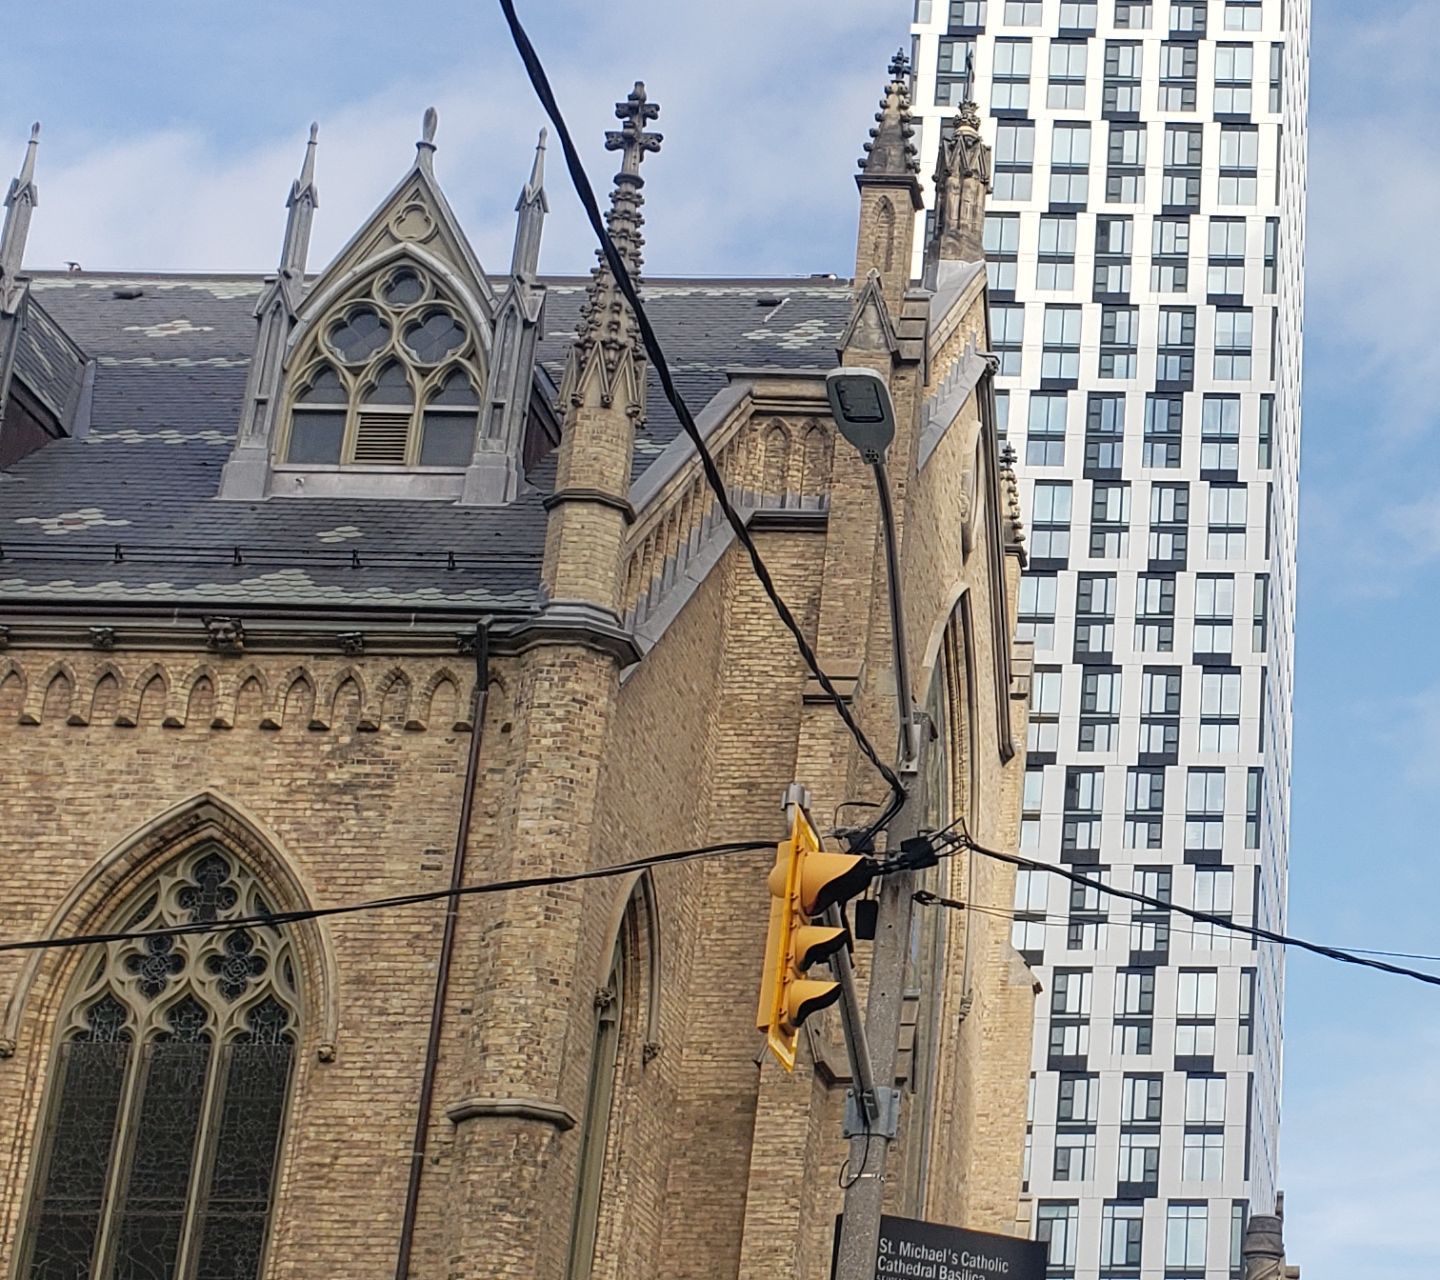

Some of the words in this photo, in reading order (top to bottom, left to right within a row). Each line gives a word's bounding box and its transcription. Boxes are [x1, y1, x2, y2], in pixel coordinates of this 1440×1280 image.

[877, 1255, 936, 1278] Cathedral
[879, 1237, 896, 1255] St.
[899, 1240, 959, 1265] Michael's
[961, 1251, 1009, 1273] Catholic
